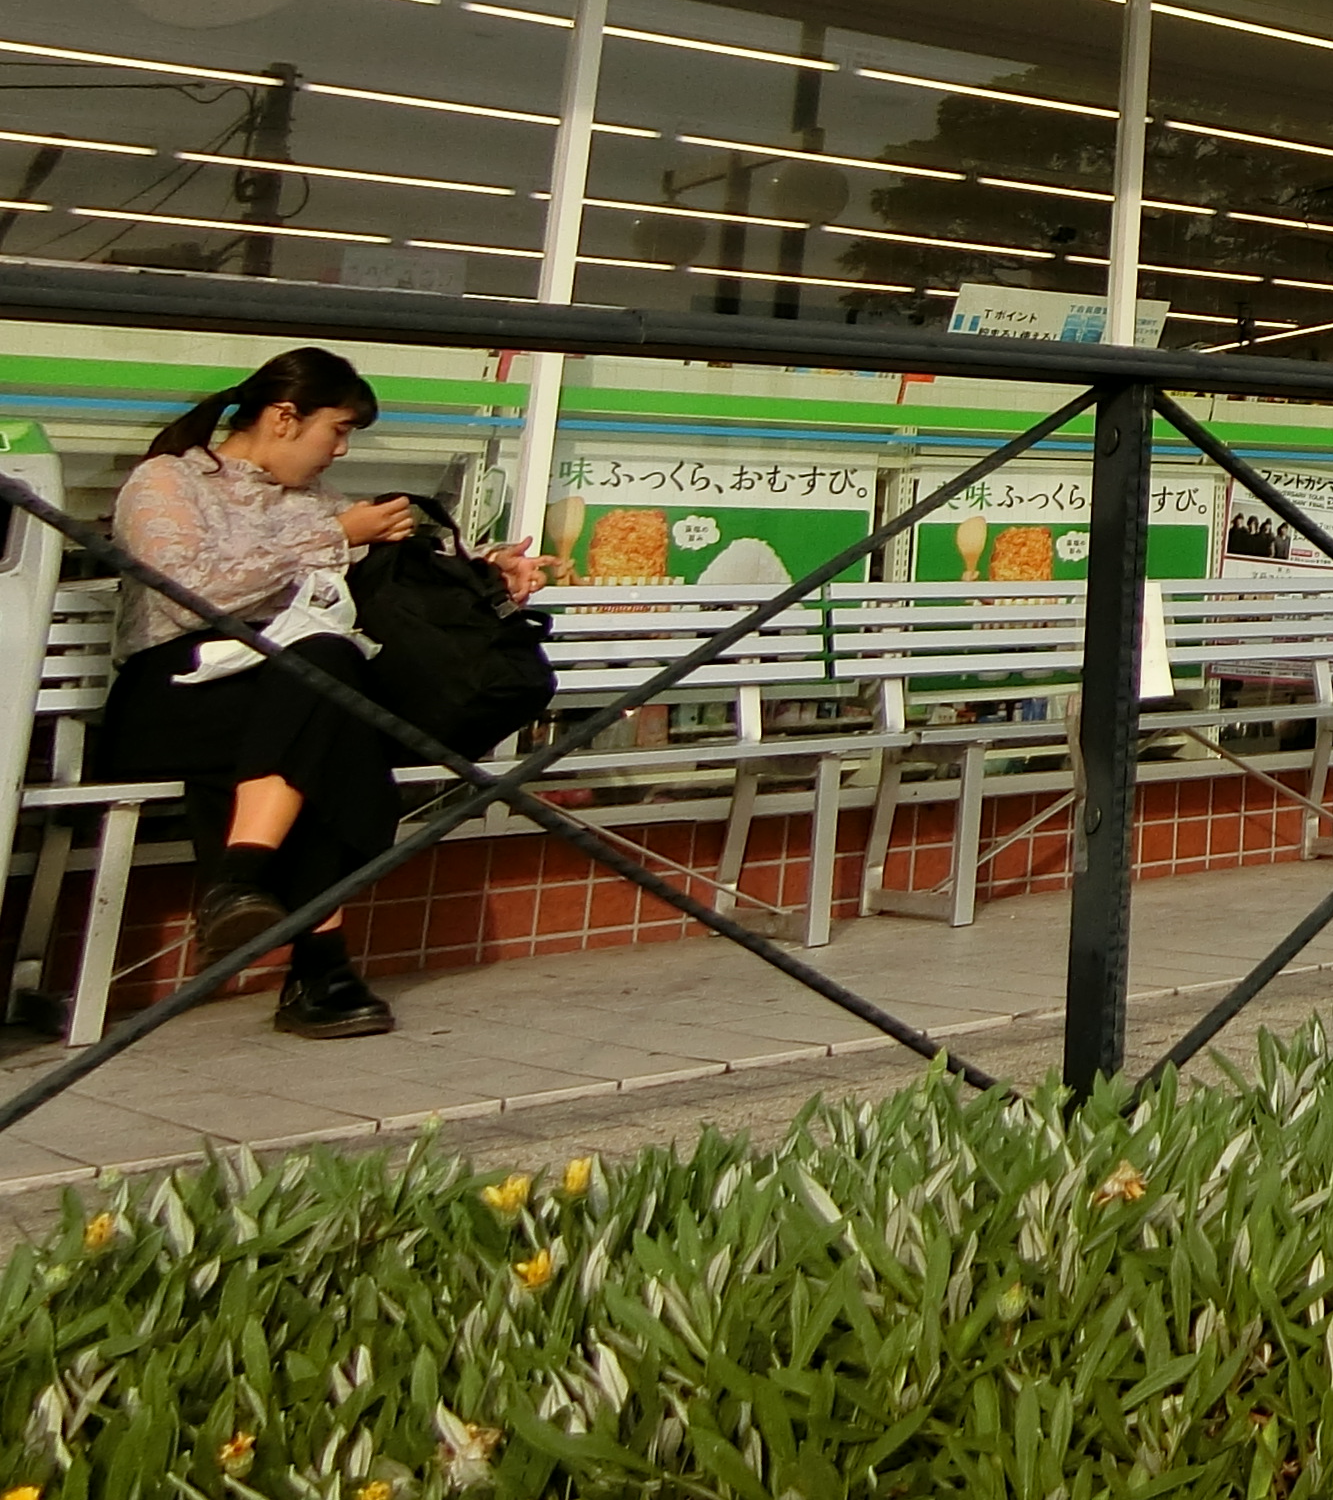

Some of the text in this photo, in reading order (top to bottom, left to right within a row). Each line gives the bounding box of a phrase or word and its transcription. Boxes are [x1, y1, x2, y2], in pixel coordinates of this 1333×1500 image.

[559, 456, 868, 499] 味ふっくら、おむすび。
